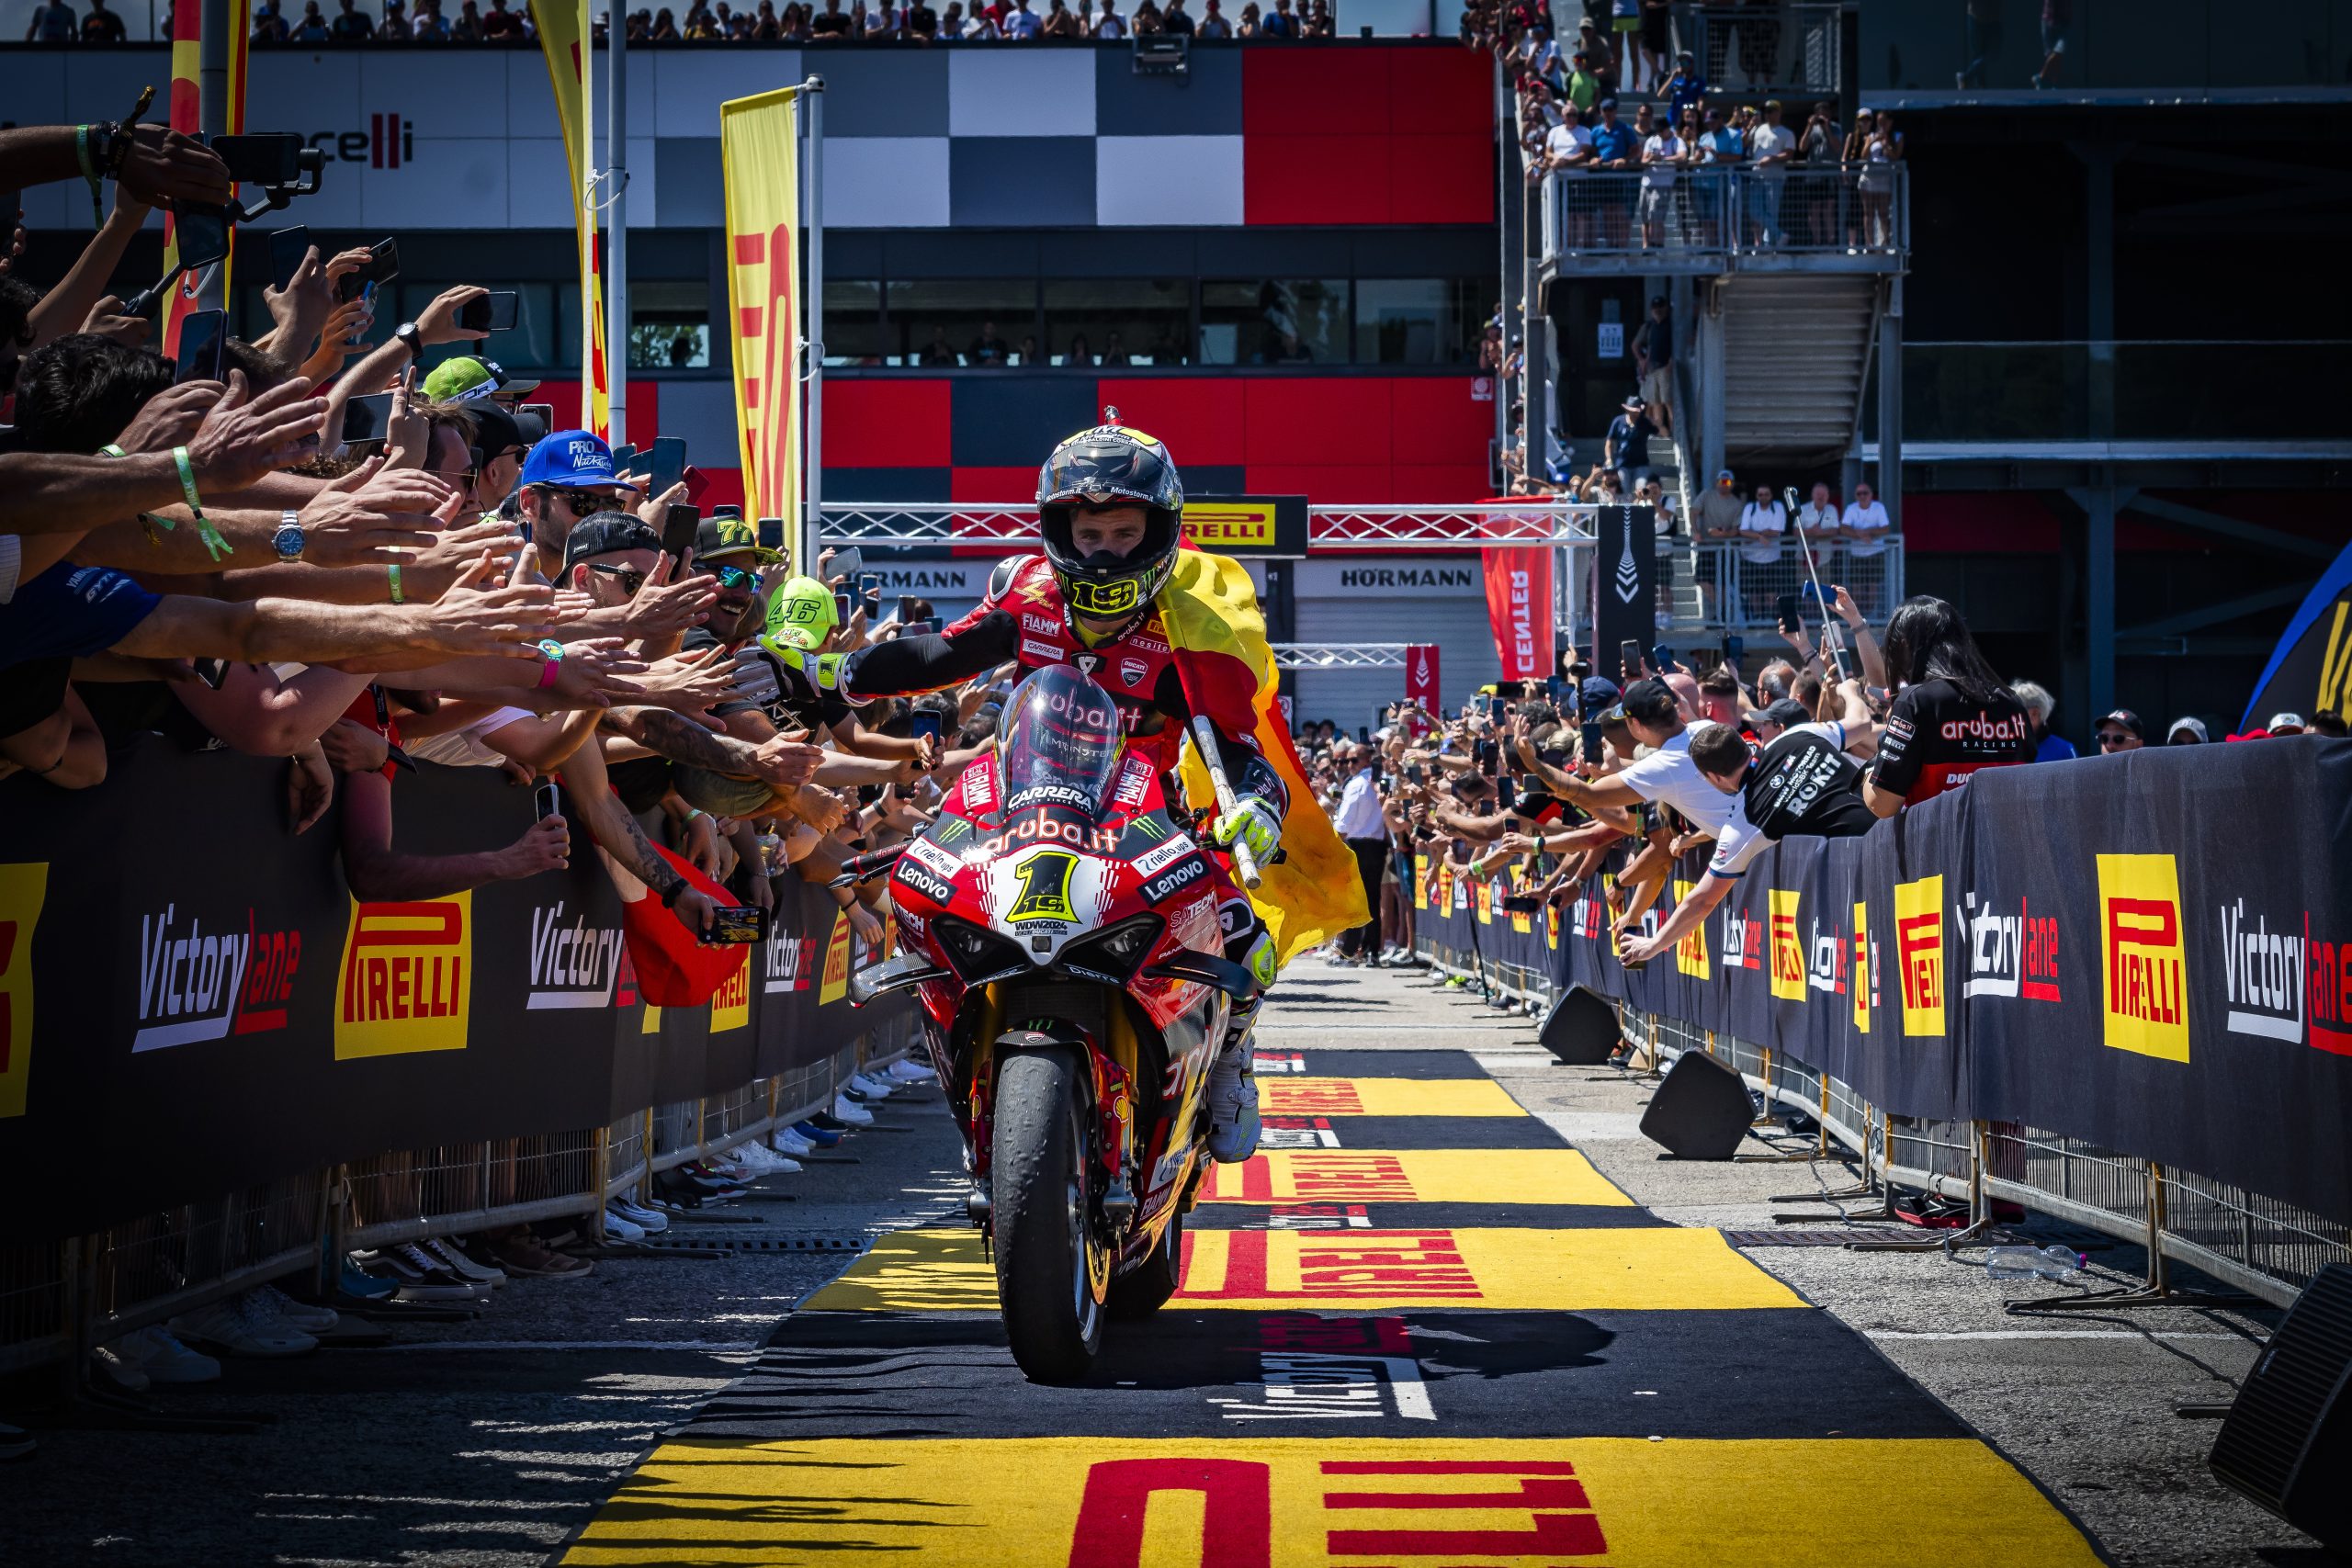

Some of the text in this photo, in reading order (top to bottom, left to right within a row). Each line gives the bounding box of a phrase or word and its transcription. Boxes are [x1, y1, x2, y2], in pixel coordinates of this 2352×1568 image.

[569, 440, 594, 455] PRO
[1110, 486, 1154, 502] Motostorm.it
[717, 519, 752, 546] 77
[1180, 513, 1265, 537] RELLI
[1072, 579, 1138, 614] 19
[768, 598, 821, 624] 46
[1023, 613, 1061, 635] FIAMM
[1027, 643, 1060, 656] CARRERA
[1124, 660, 1146, 670] DUCATI
[1941, 710, 2025, 740] aruba.it
[1008, 786, 1091, 811] CARRERA
[981, 807, 1121, 853] aruba.it
[1151, 840, 1189, 866] riello ups
[898, 861, 948, 899] Lenovo
[1004, 851, 1083, 925] 1
[1144, 860, 1204, 901] Lenovo
[1014, 920, 1068, 931] WDW2024
[343, 902, 463, 1023] PIRELLI
[2108, 897, 2181, 1025] PIRLLI
